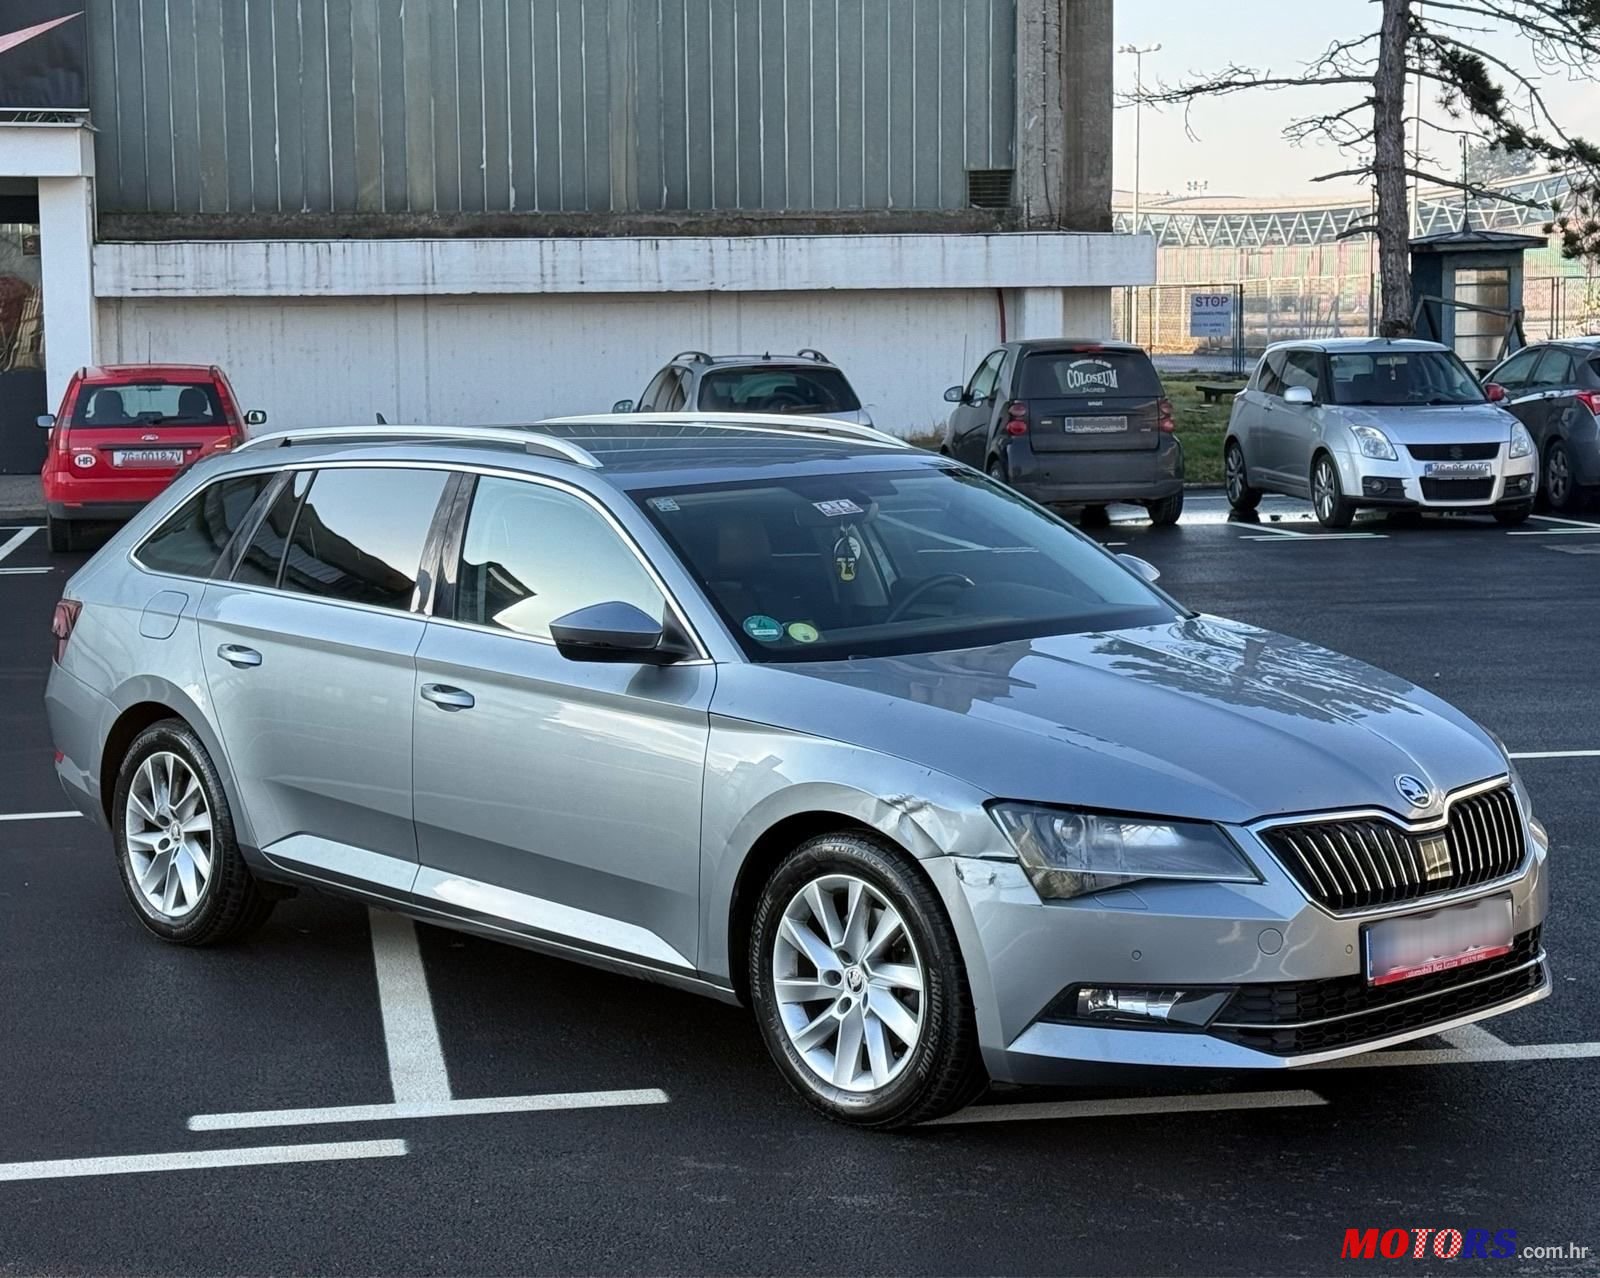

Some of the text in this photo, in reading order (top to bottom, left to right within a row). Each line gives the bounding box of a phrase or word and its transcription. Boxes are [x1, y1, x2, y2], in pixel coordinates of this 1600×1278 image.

[1195, 296, 1229, 307] STOP
[1066, 368, 1118, 389] COLOSEUM
[78, 456, 93, 465] HR
[757, 618, 767, 629] 4
[750, 893, 774, 1000] BRIDGESTONE
[916, 966, 943, 1082] BRIDGESTONE
